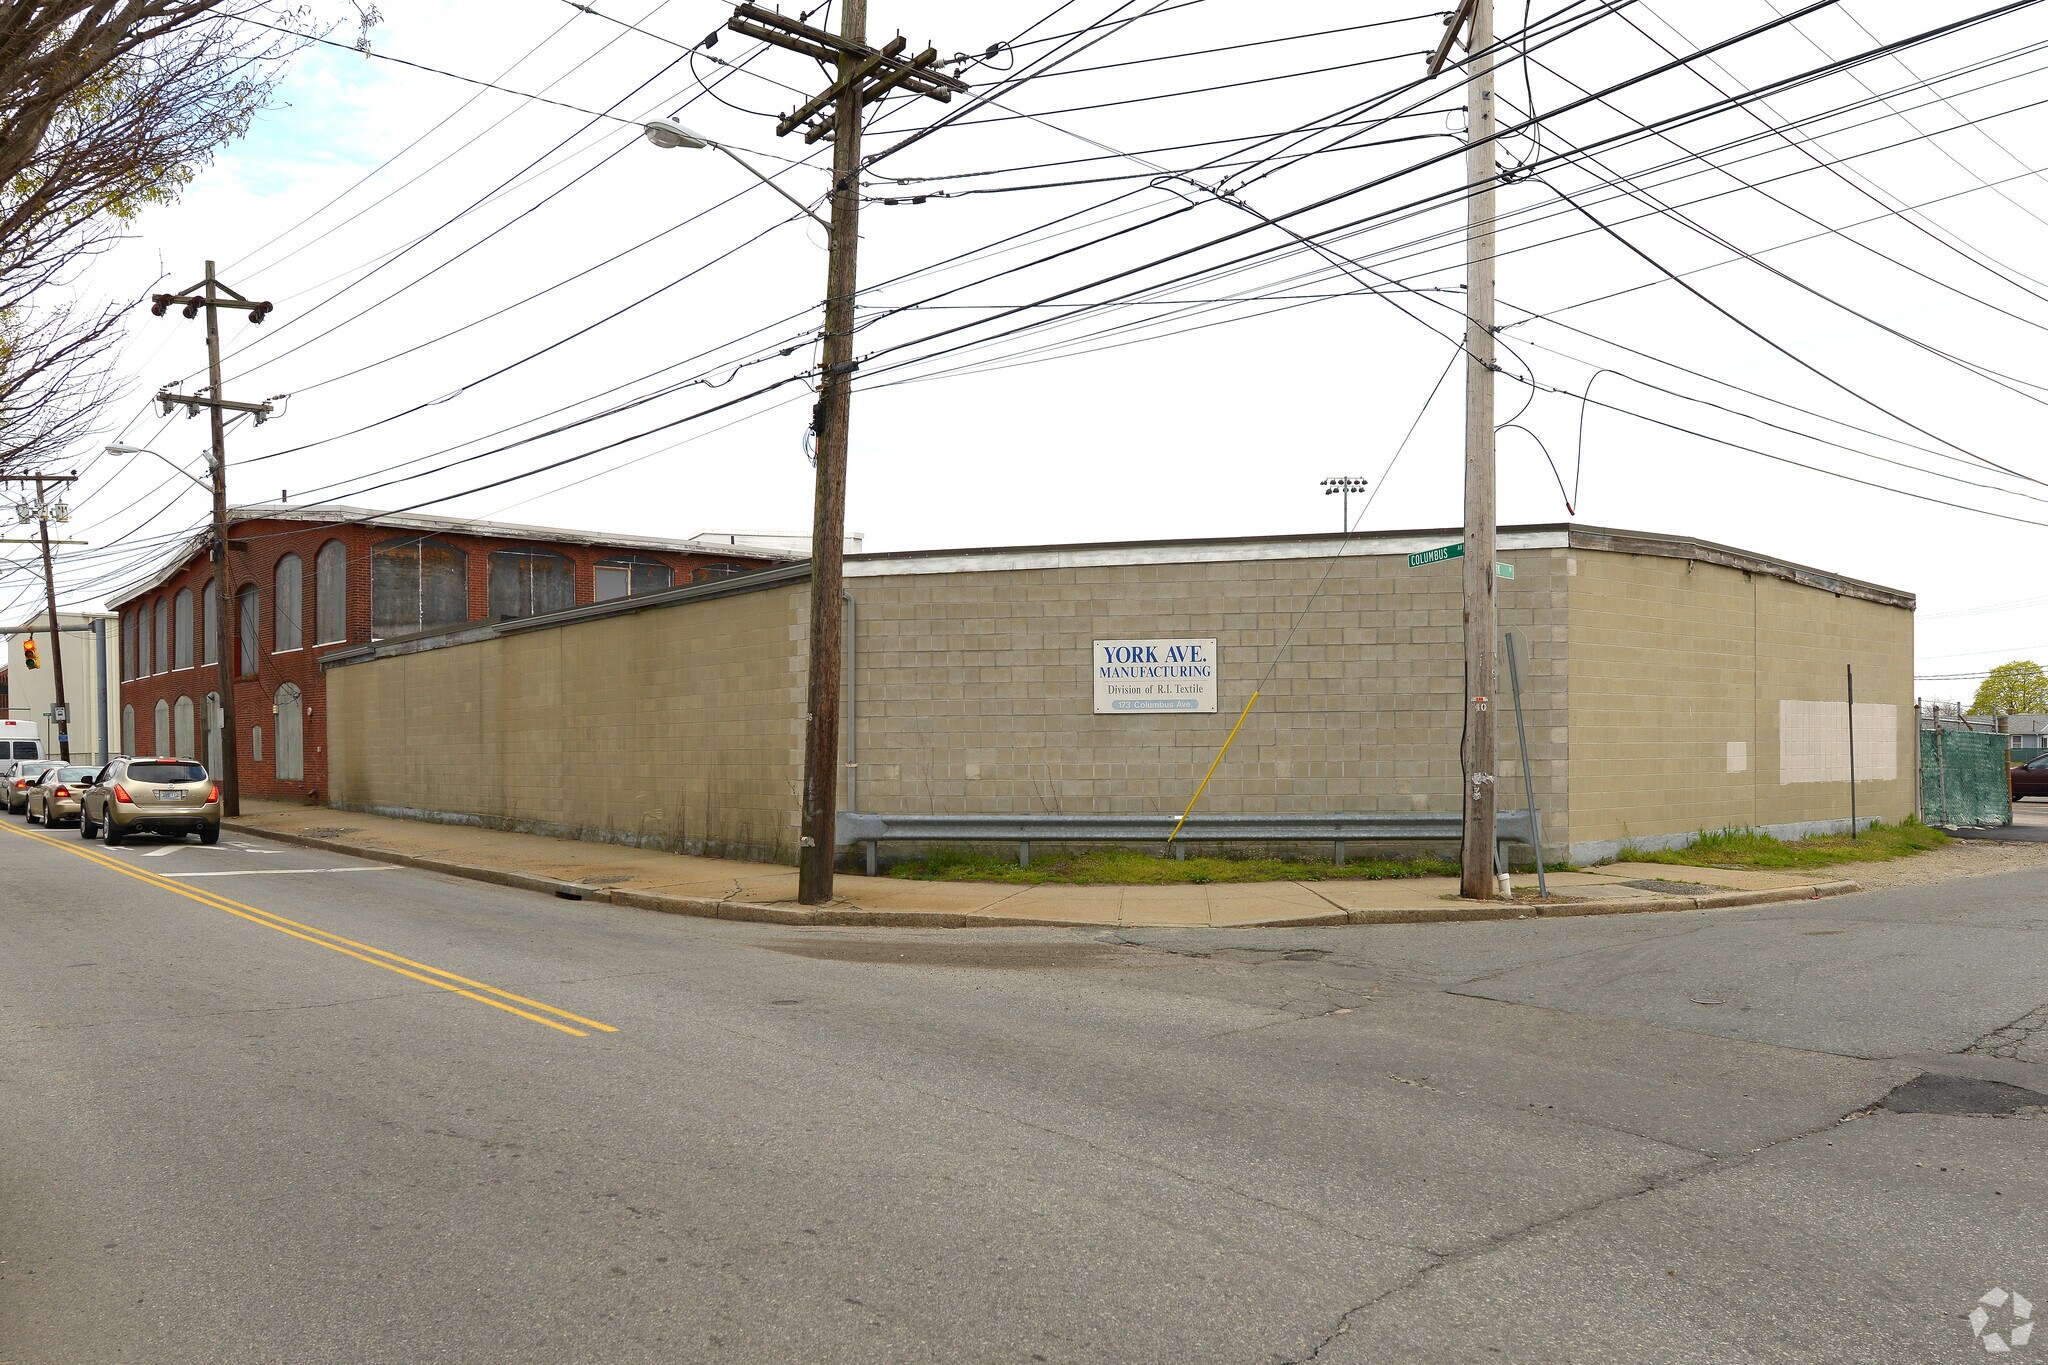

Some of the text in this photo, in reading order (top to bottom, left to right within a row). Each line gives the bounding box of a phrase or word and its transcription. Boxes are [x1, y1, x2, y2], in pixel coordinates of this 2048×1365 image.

[1411, 548, 1448, 566] COLUMBUS
[1103, 645, 1207, 663] YORK AVE.
[1099, 666, 1211, 678] MANUFACTURING
[1108, 684, 1203, 694] Division of R.I. Textile
[1118, 700, 1193, 709] 173 Columbus Ave.
